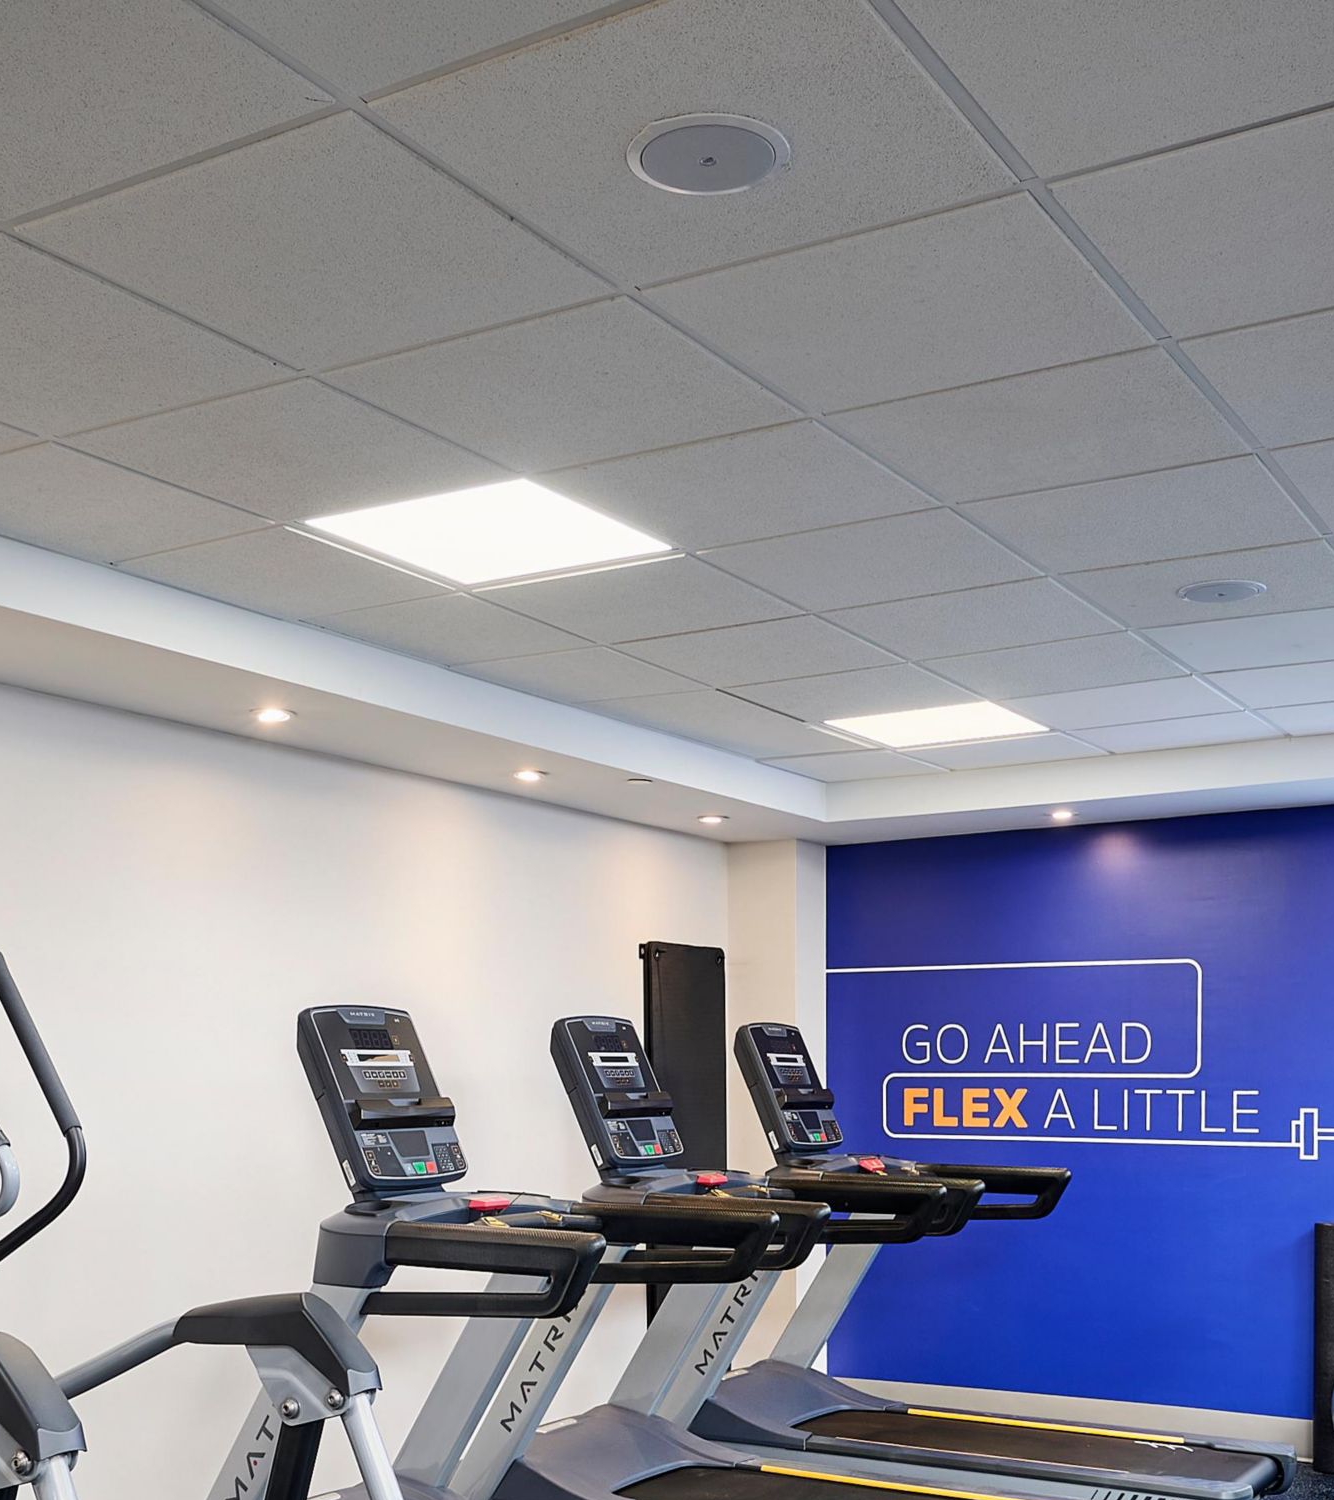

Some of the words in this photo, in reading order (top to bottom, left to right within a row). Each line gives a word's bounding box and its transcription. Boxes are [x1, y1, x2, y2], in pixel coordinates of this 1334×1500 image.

[903, 1024, 968, 1063] GO
[985, 1023, 1151, 1063] AHEAD
[903, 1088, 1028, 1128] FLEX
[1044, 1089, 1075, 1129] A
[1093, 1089, 1260, 1133] LITTLE
[694, 1274, 759, 1376] MATRI
[500, 1305, 578, 1433] MATRI
